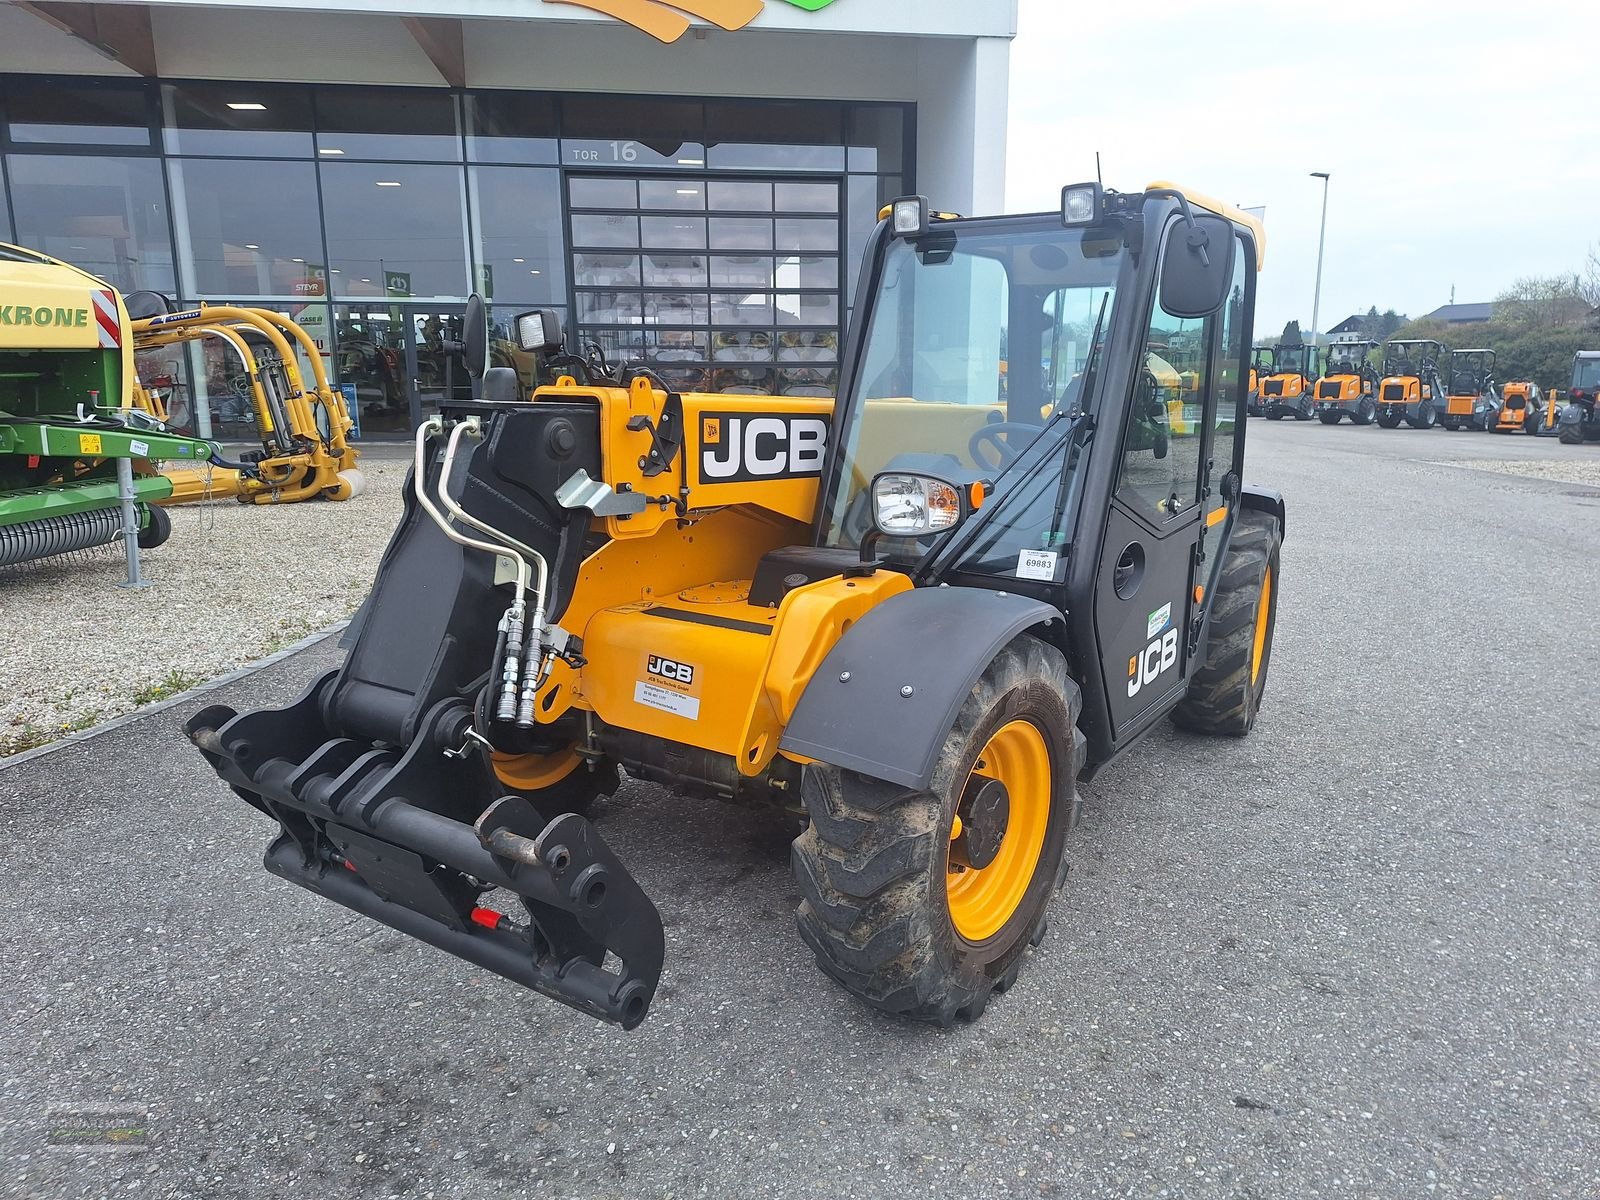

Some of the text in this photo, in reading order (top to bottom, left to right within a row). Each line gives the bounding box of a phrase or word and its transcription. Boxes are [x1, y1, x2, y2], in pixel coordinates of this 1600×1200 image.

[572, 140, 637, 162] TOR 16
[295, 283, 319, 292] STEYR
[0, 305, 89, 328] KRONE
[704, 418, 827, 478] JCB
[1026, 559, 1052, 569] 69883
[648, 658, 693, 683] JCB
[1128, 627, 1178, 698] JCB
